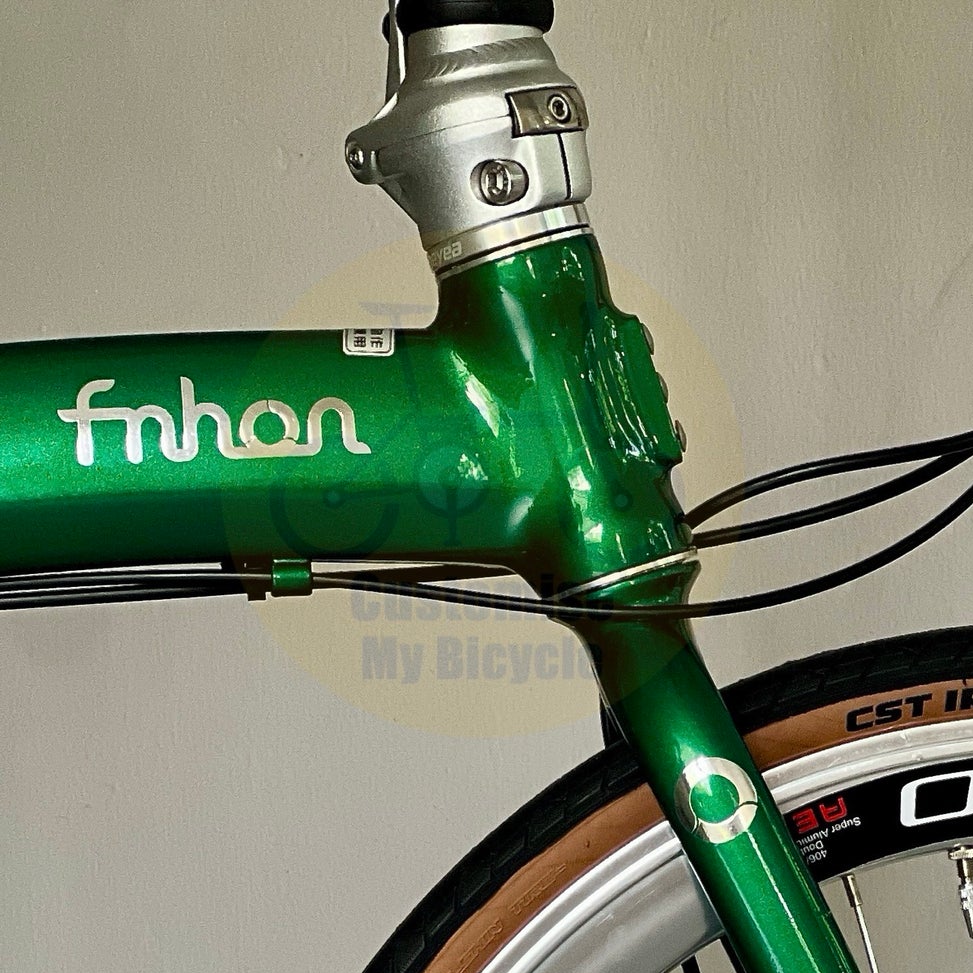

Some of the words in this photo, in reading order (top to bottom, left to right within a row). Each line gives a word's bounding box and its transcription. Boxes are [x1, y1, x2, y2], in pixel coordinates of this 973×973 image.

[57, 376, 372, 467] fnhon
[846, 693, 932, 732] CST
[831, 816, 862, 833] Super
